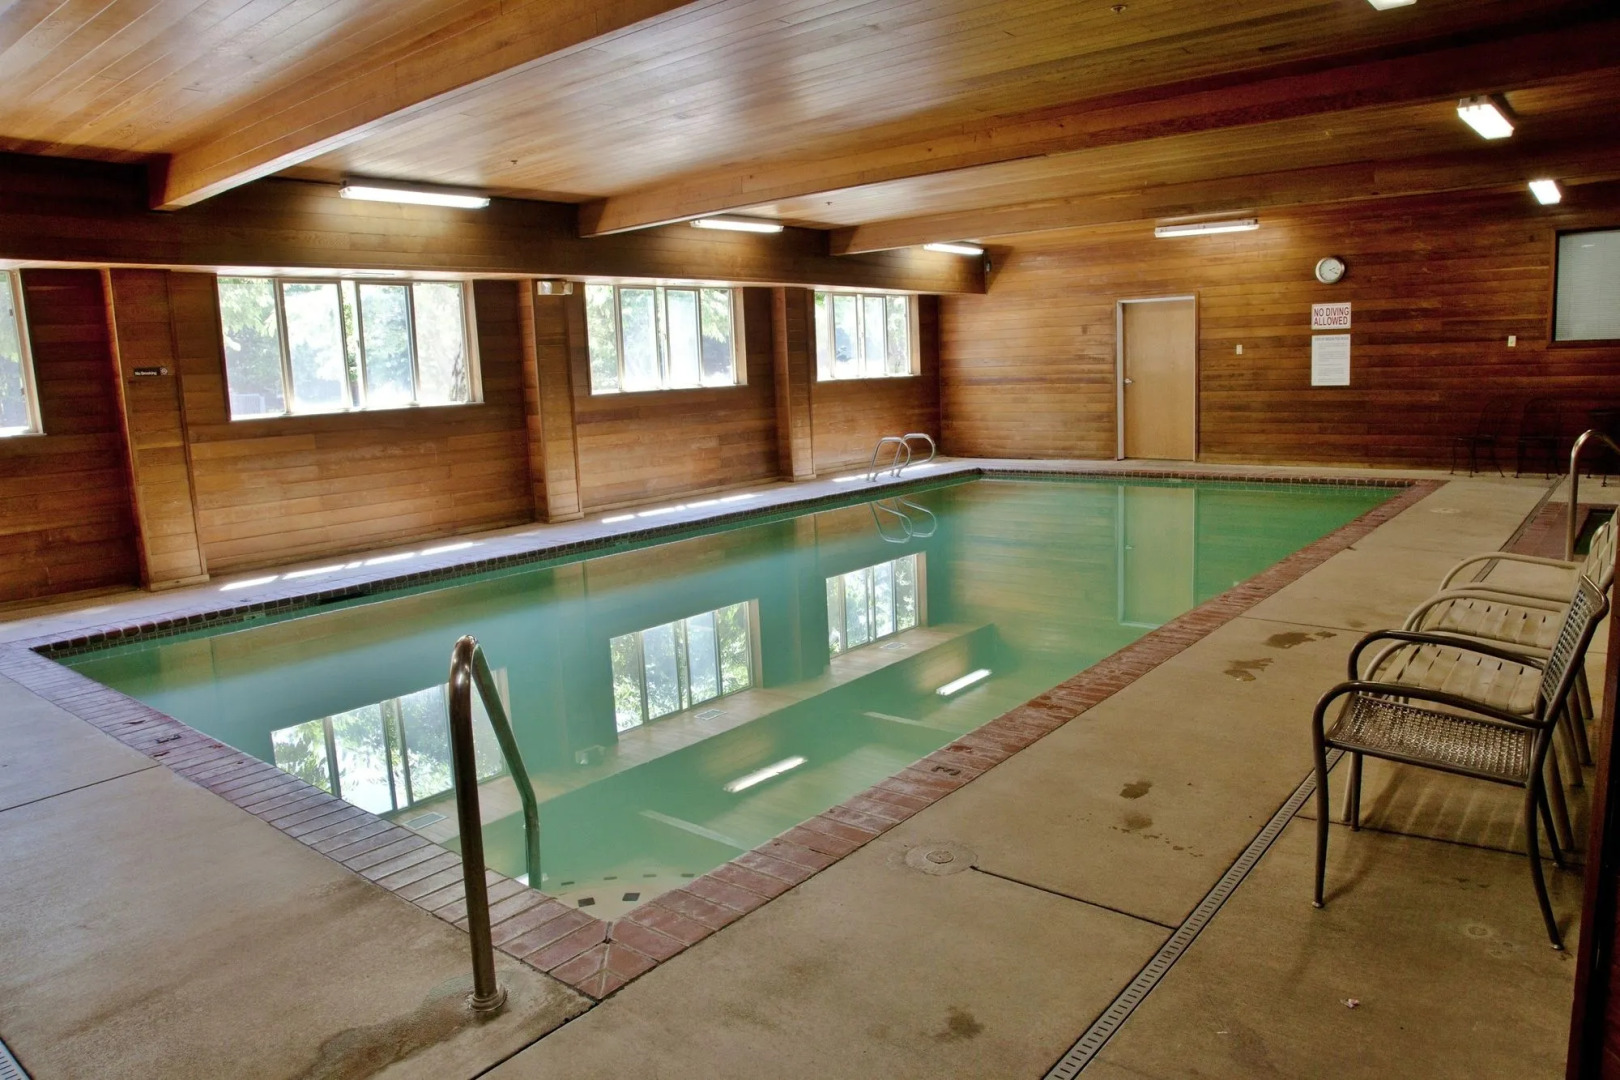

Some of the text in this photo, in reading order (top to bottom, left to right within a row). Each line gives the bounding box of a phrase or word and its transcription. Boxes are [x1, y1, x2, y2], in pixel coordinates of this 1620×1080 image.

[1314, 306, 1350, 317] NO DIVING
[1314, 316, 1348, 326] ALLOWED
